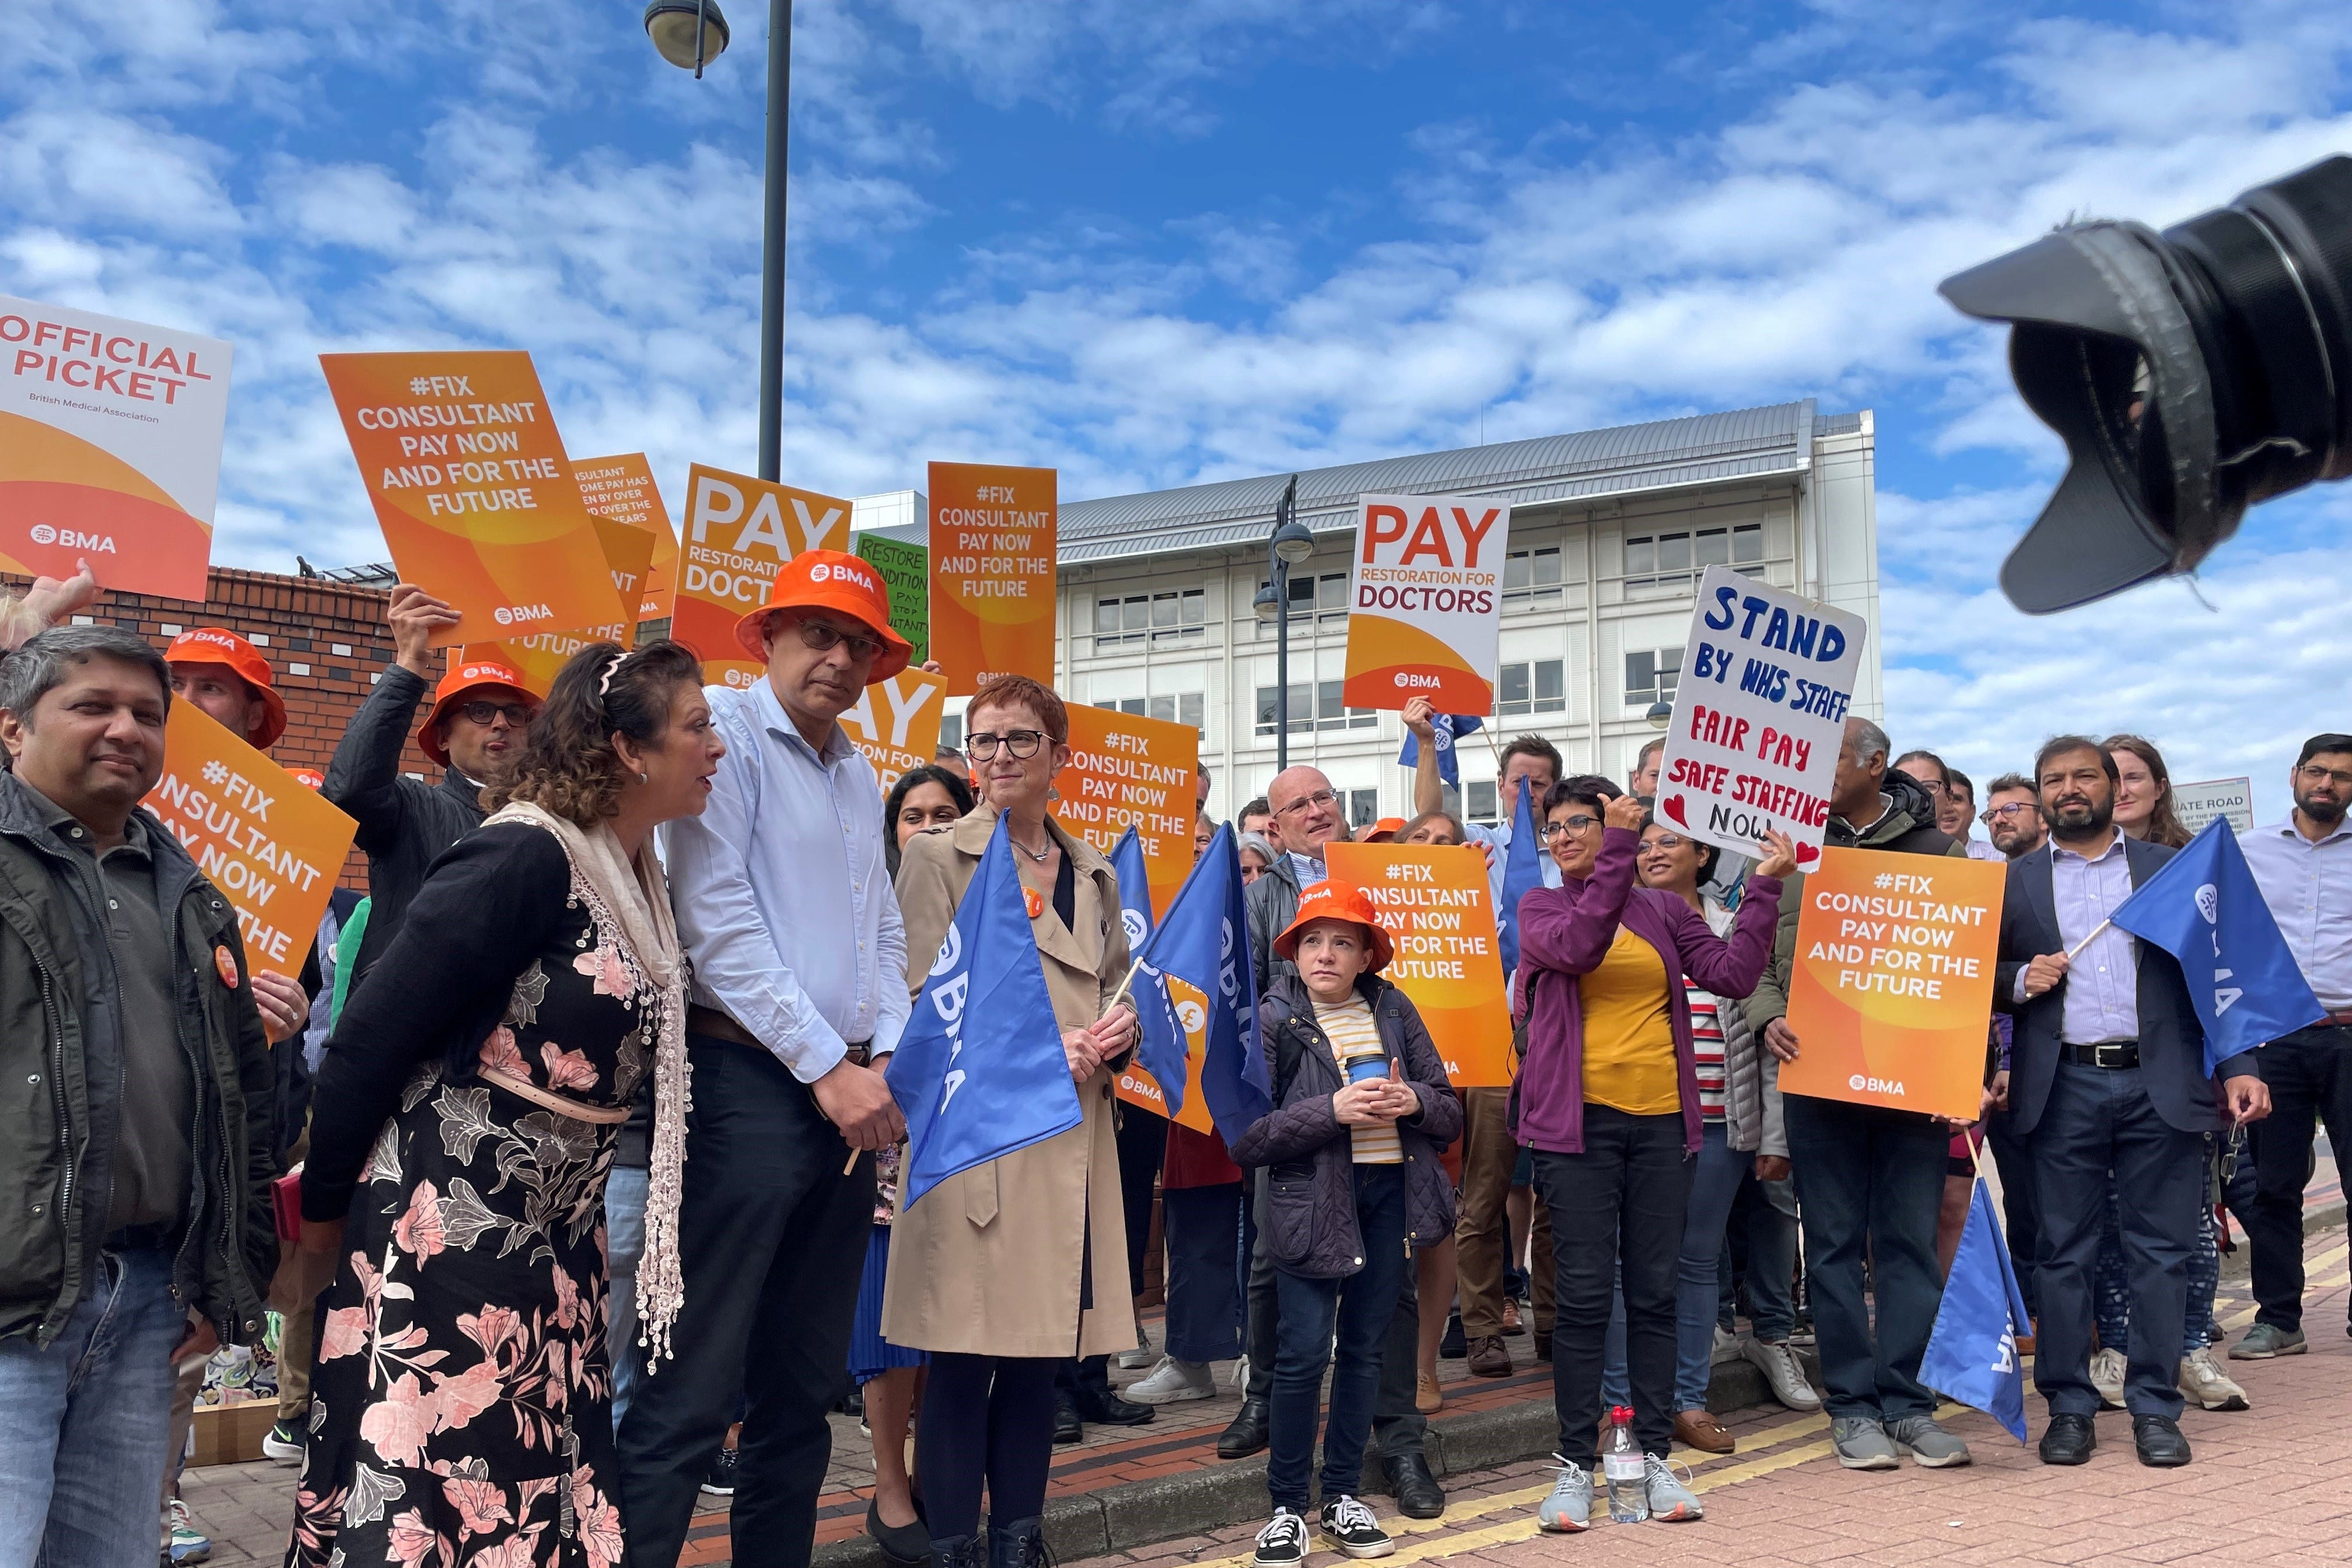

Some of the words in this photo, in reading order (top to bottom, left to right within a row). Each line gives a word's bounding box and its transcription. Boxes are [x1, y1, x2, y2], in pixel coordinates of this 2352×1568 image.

[0, 314, 212, 381] OFFICIAL
[14, 349, 186, 405] PICKET
[410, 376, 474, 397] #FIX
[29, 392, 60, 406] British
[62, 398, 101, 413] Medical
[103, 406, 159, 424] Association
[358, 402, 535, 430] CONSULTANT
[400, 435, 448, 457] PAY
[455, 431, 519, 455] NOW
[383, 464, 442, 489] AND
[446, 461, 504, 485] FOR
[504, 458, 560, 481] THE
[575, 467, 625, 481] NSULTANT
[580, 482, 604, 493] OME
[606, 480, 624, 490] PAY
[628, 476, 649, 487] HAS
[426, 488, 537, 516] FUTURE
[583, 495, 598, 505] EN
[600, 493, 612, 503] BY
[614, 489, 643, 501] OVER
[600, 503, 630, 514] OVER
[631, 500, 652, 510] THE
[977, 485, 1015, 504] #FIX
[691, 476, 844, 562] PAY
[939, 508, 1049, 528] CONSULTANT
[59, 530, 116, 554] BMA
[959, 533, 989, 551] PAY
[993, 534, 1031, 551] NOW
[1363, 505, 1502, 568] PAY
[689, 545, 782, 578] RESTORATI
[860, 538, 924, 569] RESTORE
[939, 556, 977, 573] AND
[981, 557, 1013, 574] FOR
[1016, 557, 1048, 575] THE
[685, 564, 774, 606] DOCT
[834, 565, 874, 593] BMA
[873, 564, 928, 591] ONDITION
[963, 580, 1027, 597] FUTURE
[1360, 568, 1462, 584] RESTORATION
[1465, 572, 1495, 586] FOR
[639, 601, 658, 613] MA
[893, 606, 917, 615] STOP
[897, 592, 921, 606] PAY
[1359, 585, 1493, 614] DOCTORS
[513, 603, 554, 622] BMA
[1704, 586, 1846, 662] STAND
[194, 631, 236, 652] BMA
[509, 634, 593, 656] UTUR
[481, 666, 514, 683] BMA
[1409, 675, 1441, 689] BMA
[1694, 642, 1734, 684] BY
[1740, 658, 1790, 704] NHS
[1790, 678, 1851, 724] STAFF
[837, 676, 937, 748] AY
[1105, 732, 1149, 756] #FIX
[1690, 705, 1749, 752] FAIR
[1758, 727, 1811, 772] PAY
[890, 751, 925, 769] FOR
[202, 760, 275, 823] #FIX
[1082, 778, 1117, 800] PAY
[1121, 784, 1167, 808] NOW
[1668, 758, 1730, 794] SAFE
[1731, 774, 1831, 828] STAFFING
[2207, 796, 2243, 808] ROAD
[1057, 800, 1101, 822] AND
[1106, 806, 1144, 830] FOR
[1148, 813, 1185, 835] THE
[1709, 804, 1773, 841] NOW
[152, 773, 321, 892] NSULTANT
[1084, 828, 1160, 857] FUTRE
[199, 842, 276, 907] NOW
[1385, 864, 1434, 882] #FIX
[1874, 873, 1933, 896] #FIX
[1357, 887, 1479, 907] ONSULTANT
[1815, 891, 1987, 926] CONSULTANT
[233, 905, 292, 963] THE
[1412, 912, 1461, 930] NOW
[1840, 919, 1887, 941] PAY
[1892, 926, 1954, 949] NOW
[1400, 936, 1443, 954] FOR
[1446, 937, 1489, 955] THE
[1381, 960, 1465, 979] FUTURE
[1808, 942, 1864, 964] AND
[1870, 947, 1922, 972] FOR
[1927, 953, 1979, 978] THE
[1839, 970, 1942, 1000] FUTURE
[1133, 1081, 1162, 1102] BMA
[1867, 1078, 1905, 1096] BMA
